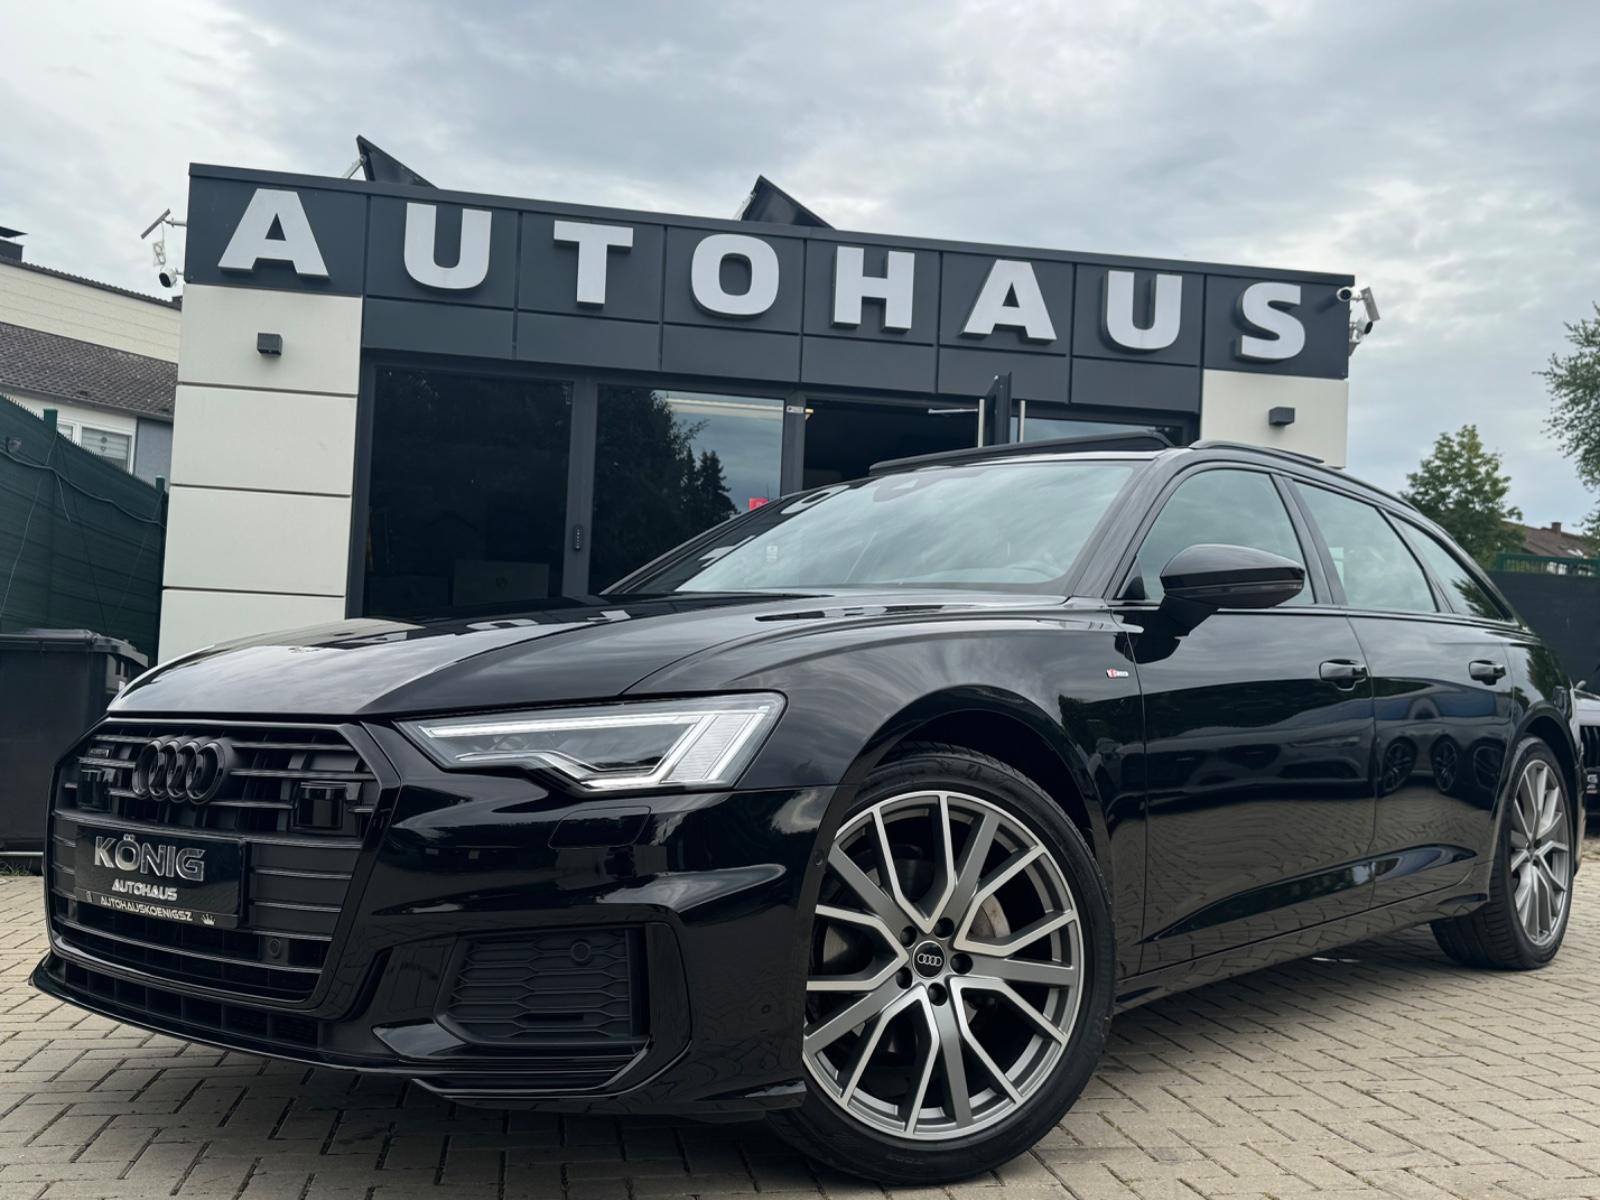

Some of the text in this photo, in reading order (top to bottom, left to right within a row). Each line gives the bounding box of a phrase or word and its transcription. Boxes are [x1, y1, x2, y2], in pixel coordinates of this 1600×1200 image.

[218, 188, 1306, 362] AUTOHAUS
[95, 834, 206, 882] KÖNIG
[112, 878, 178, 901] AUTOHAUS
[101, 896, 193, 922] AUTOHAUSKOENIGSZ
